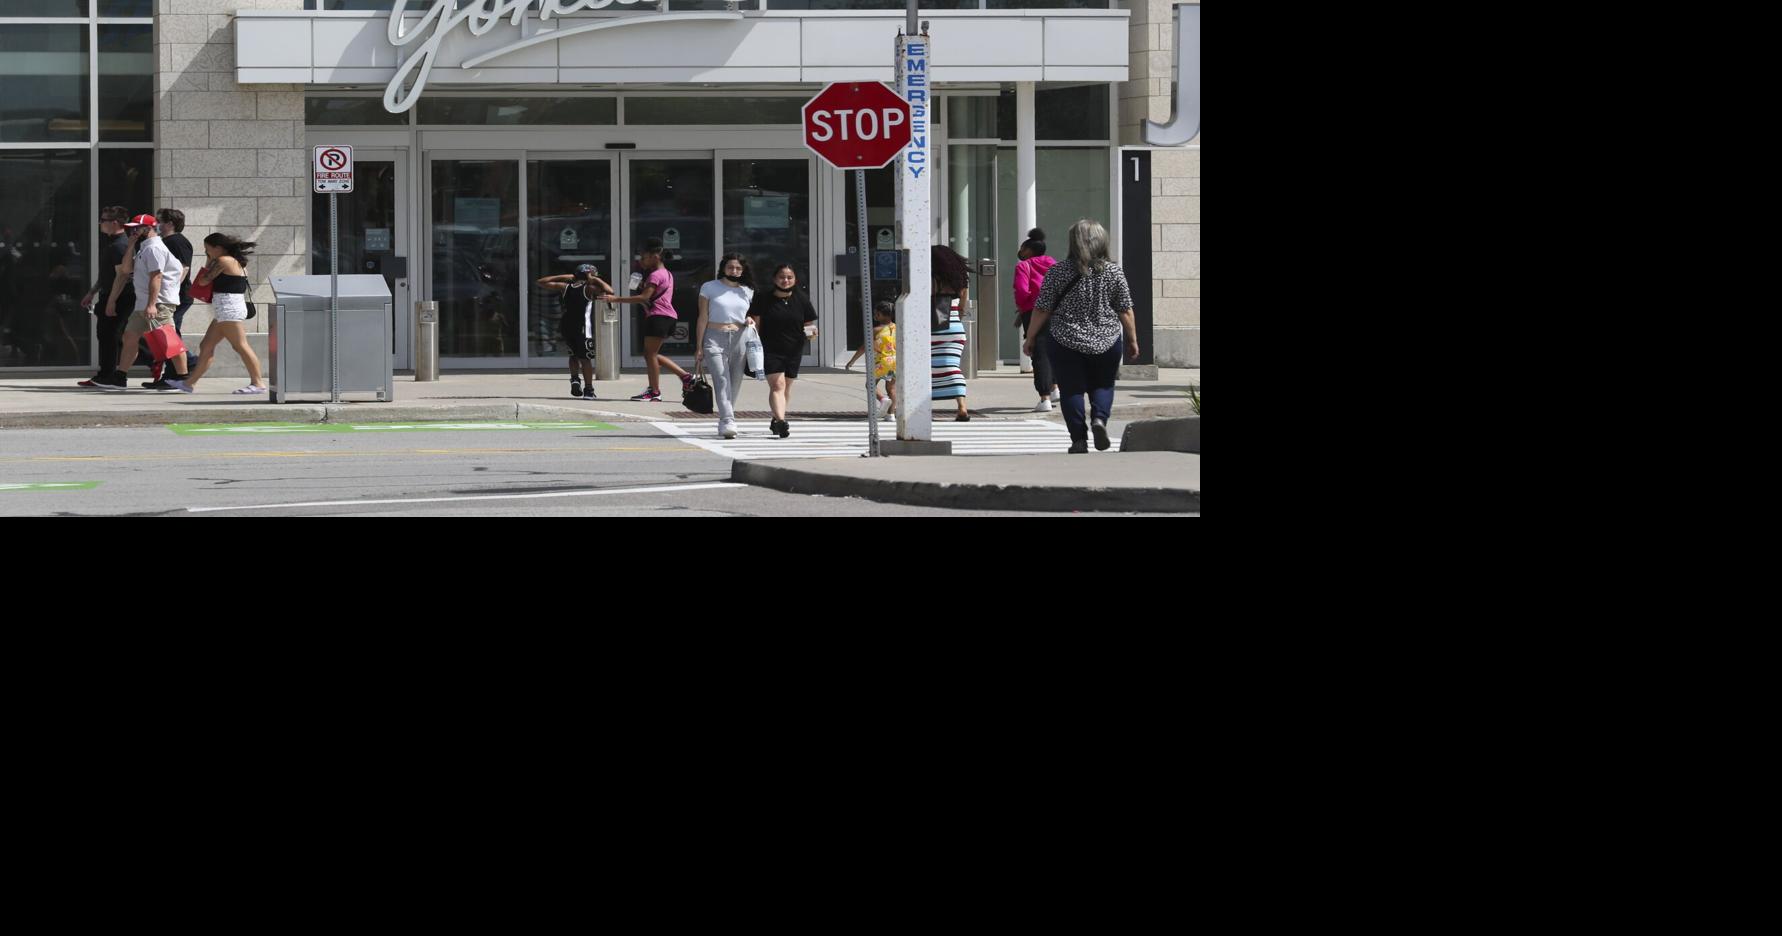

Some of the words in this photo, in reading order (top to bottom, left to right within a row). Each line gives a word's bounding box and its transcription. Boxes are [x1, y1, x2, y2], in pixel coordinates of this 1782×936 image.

[906, 43, 926, 179] EMERGENCY
[1141, 3, 1200, 147] J
[811, 108, 905, 142] STOP
[1130, 157, 1140, 182] 1
